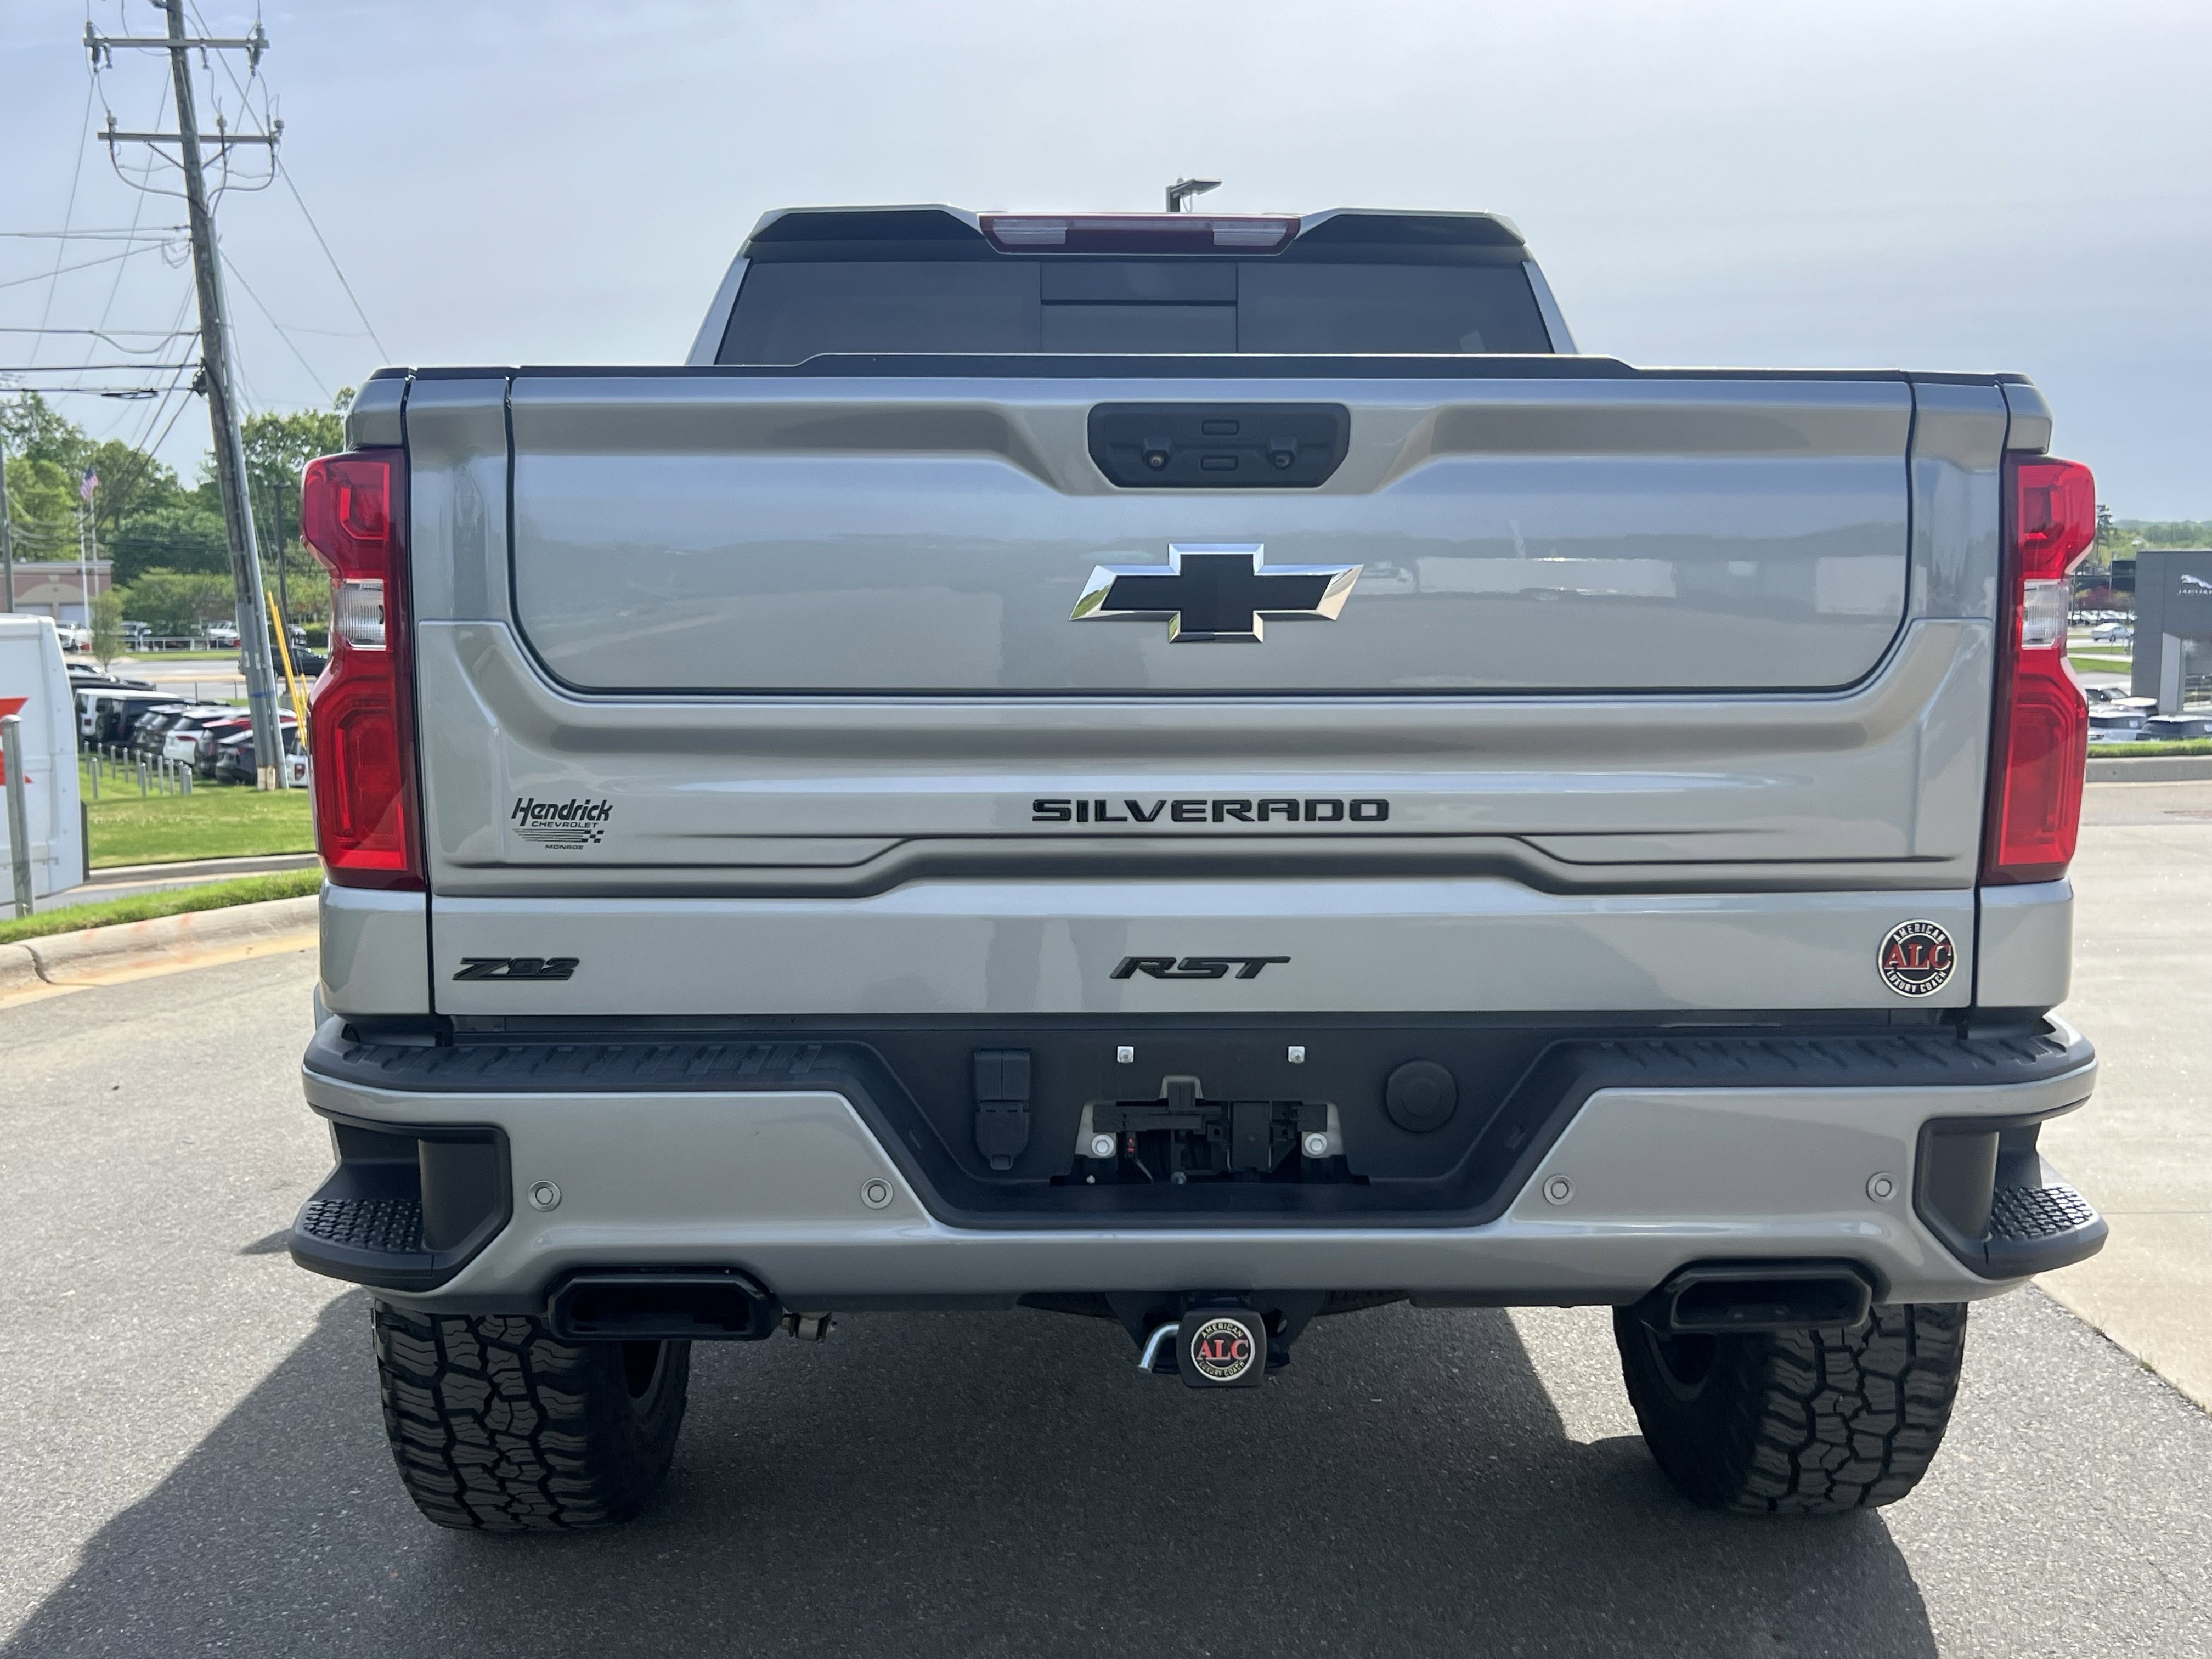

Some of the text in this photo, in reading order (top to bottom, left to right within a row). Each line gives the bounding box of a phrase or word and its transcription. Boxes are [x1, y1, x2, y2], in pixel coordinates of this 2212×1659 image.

[511, 798, 613, 827] Hendrick
[1032, 799, 1389, 822] SILVERADO
[1893, 923, 1946, 943] AMERICAN
[1109, 956, 1291, 979] RST
[1884, 943, 1951, 970] ALC
[1886, 970, 1947, 992] LUXURY COACH
[1201, 1323, 1244, 1338] AMERICAN
[1196, 1339, 1249, 1361] ALC
[1224, 1361, 1245, 1377] COACH
